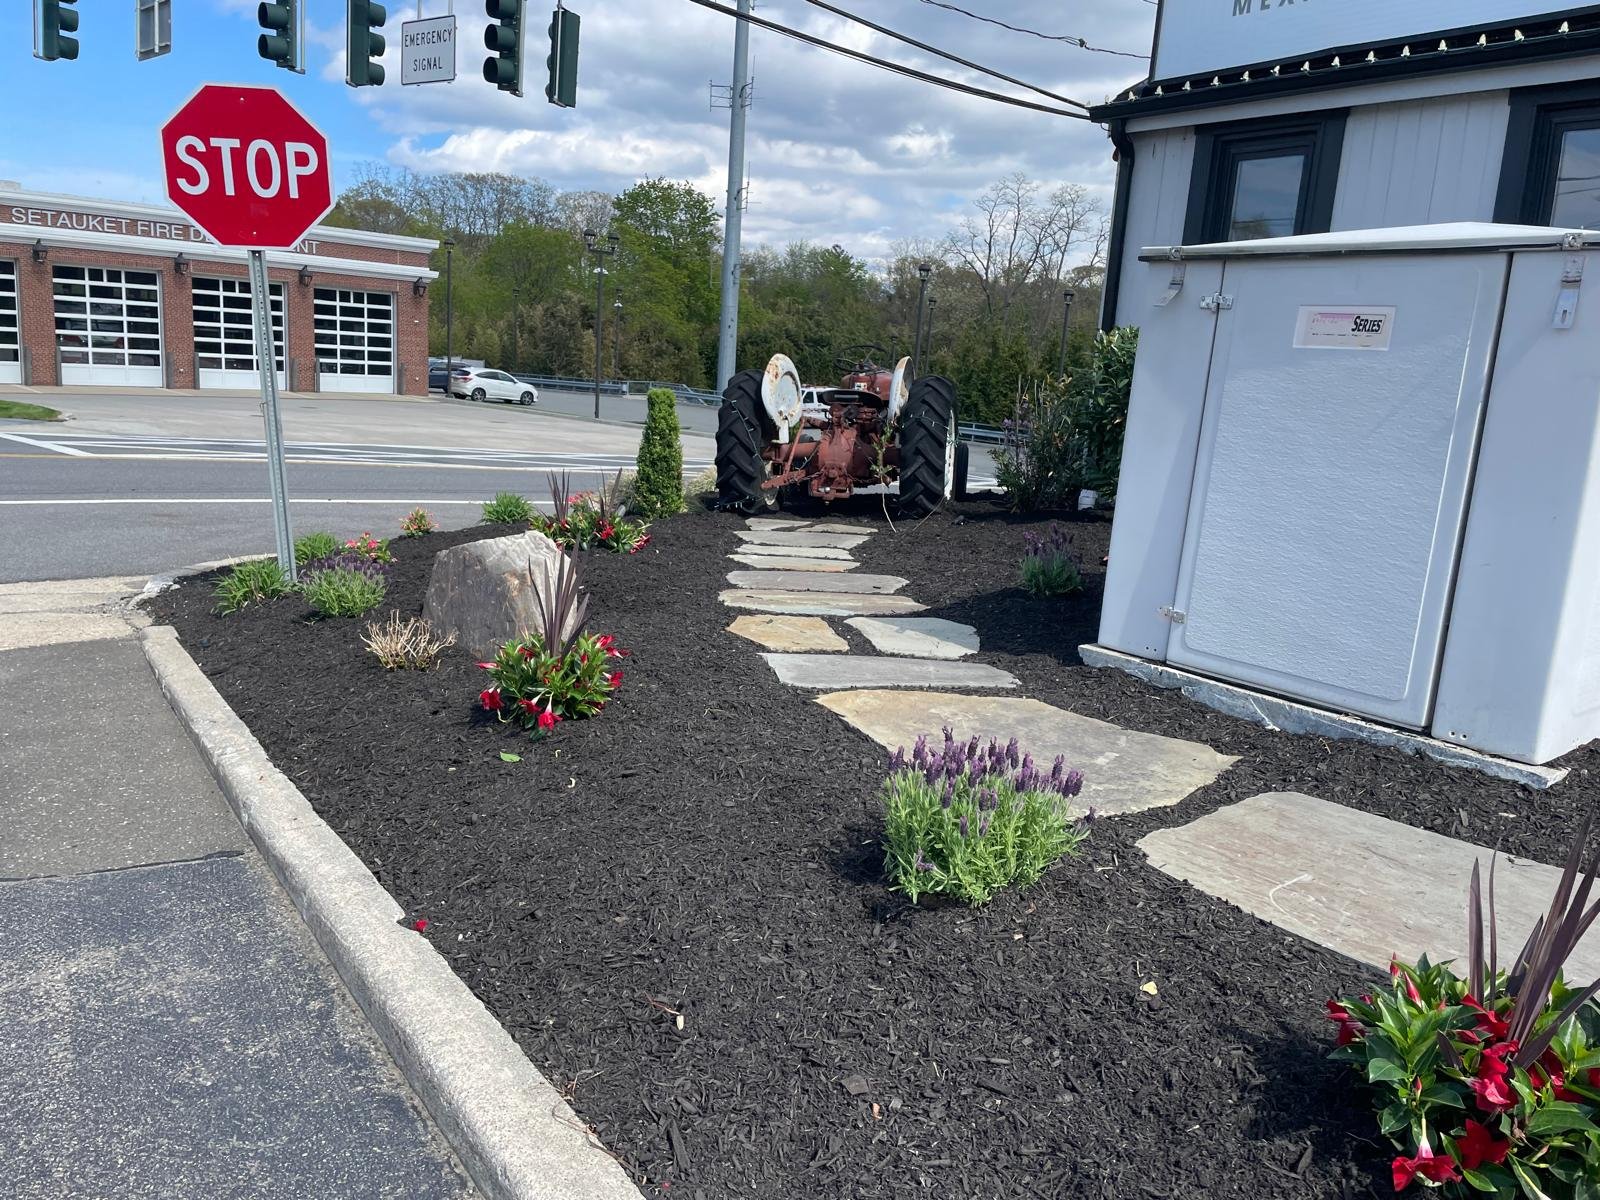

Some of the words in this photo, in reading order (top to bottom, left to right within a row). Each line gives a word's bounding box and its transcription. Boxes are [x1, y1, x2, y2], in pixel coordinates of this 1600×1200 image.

[404, 28, 452, 47] EMERGENCY
[413, 56, 442, 71] SIGNAL
[175, 135, 319, 199] STOP
[11, 207, 130, 234] SETAUKET
[136, 220, 183, 239] FIRE
[1351, 315, 1382, 332] SERIES
